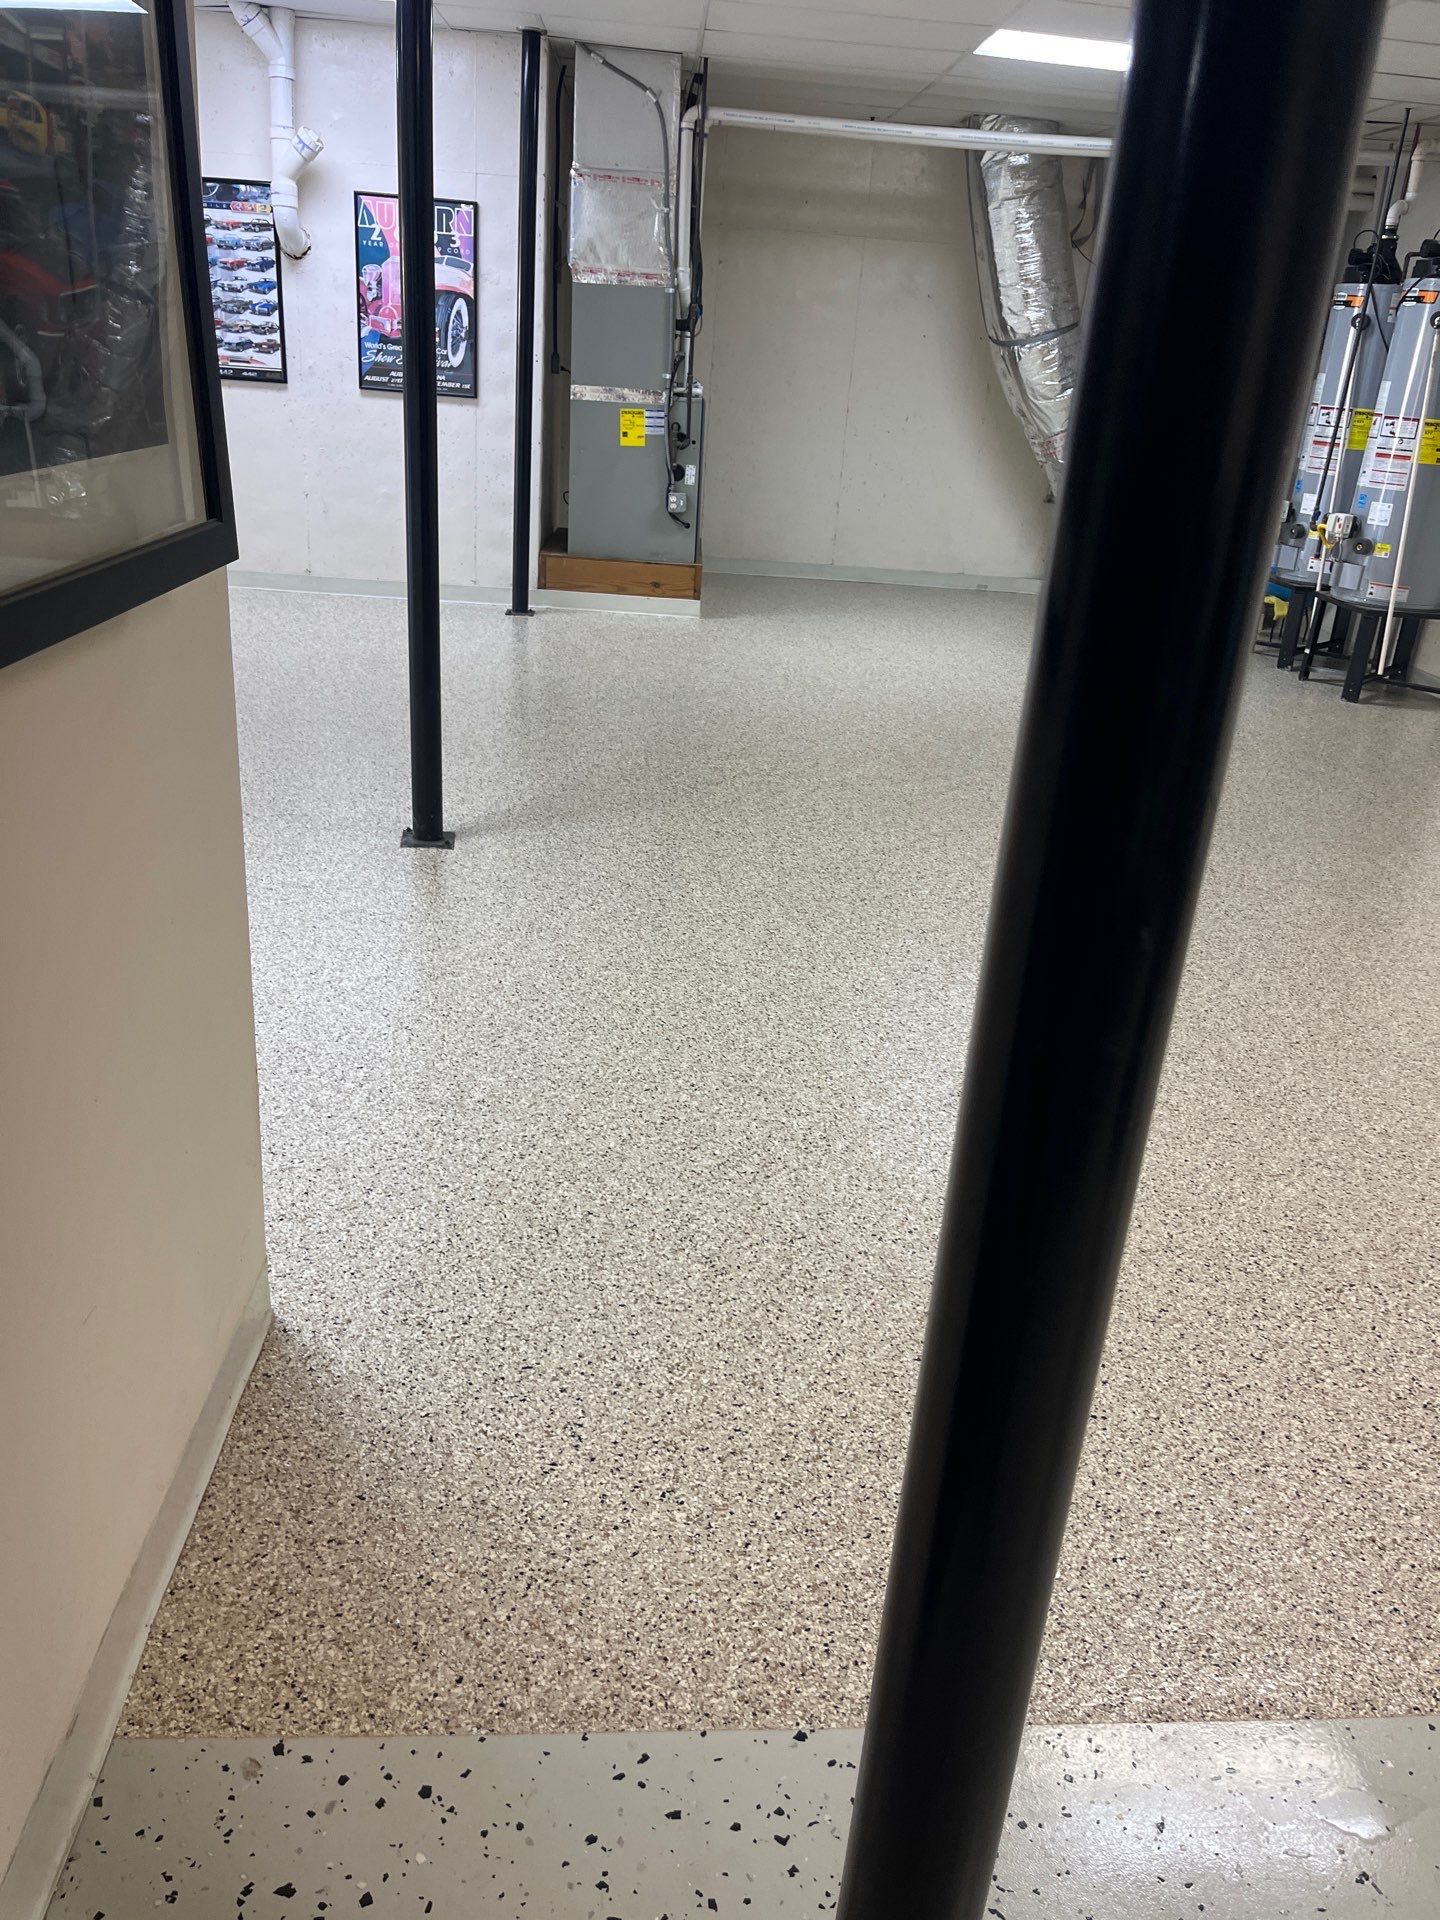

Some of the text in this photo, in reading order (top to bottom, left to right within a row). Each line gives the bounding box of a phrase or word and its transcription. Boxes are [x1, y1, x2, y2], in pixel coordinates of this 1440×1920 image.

[358, 200, 474, 237] AURN
[447, 247, 471, 255] CORD
[364, 342, 386, 350] World's
[436, 347, 448, 355] Car
[362, 350, 396, 364] Show
